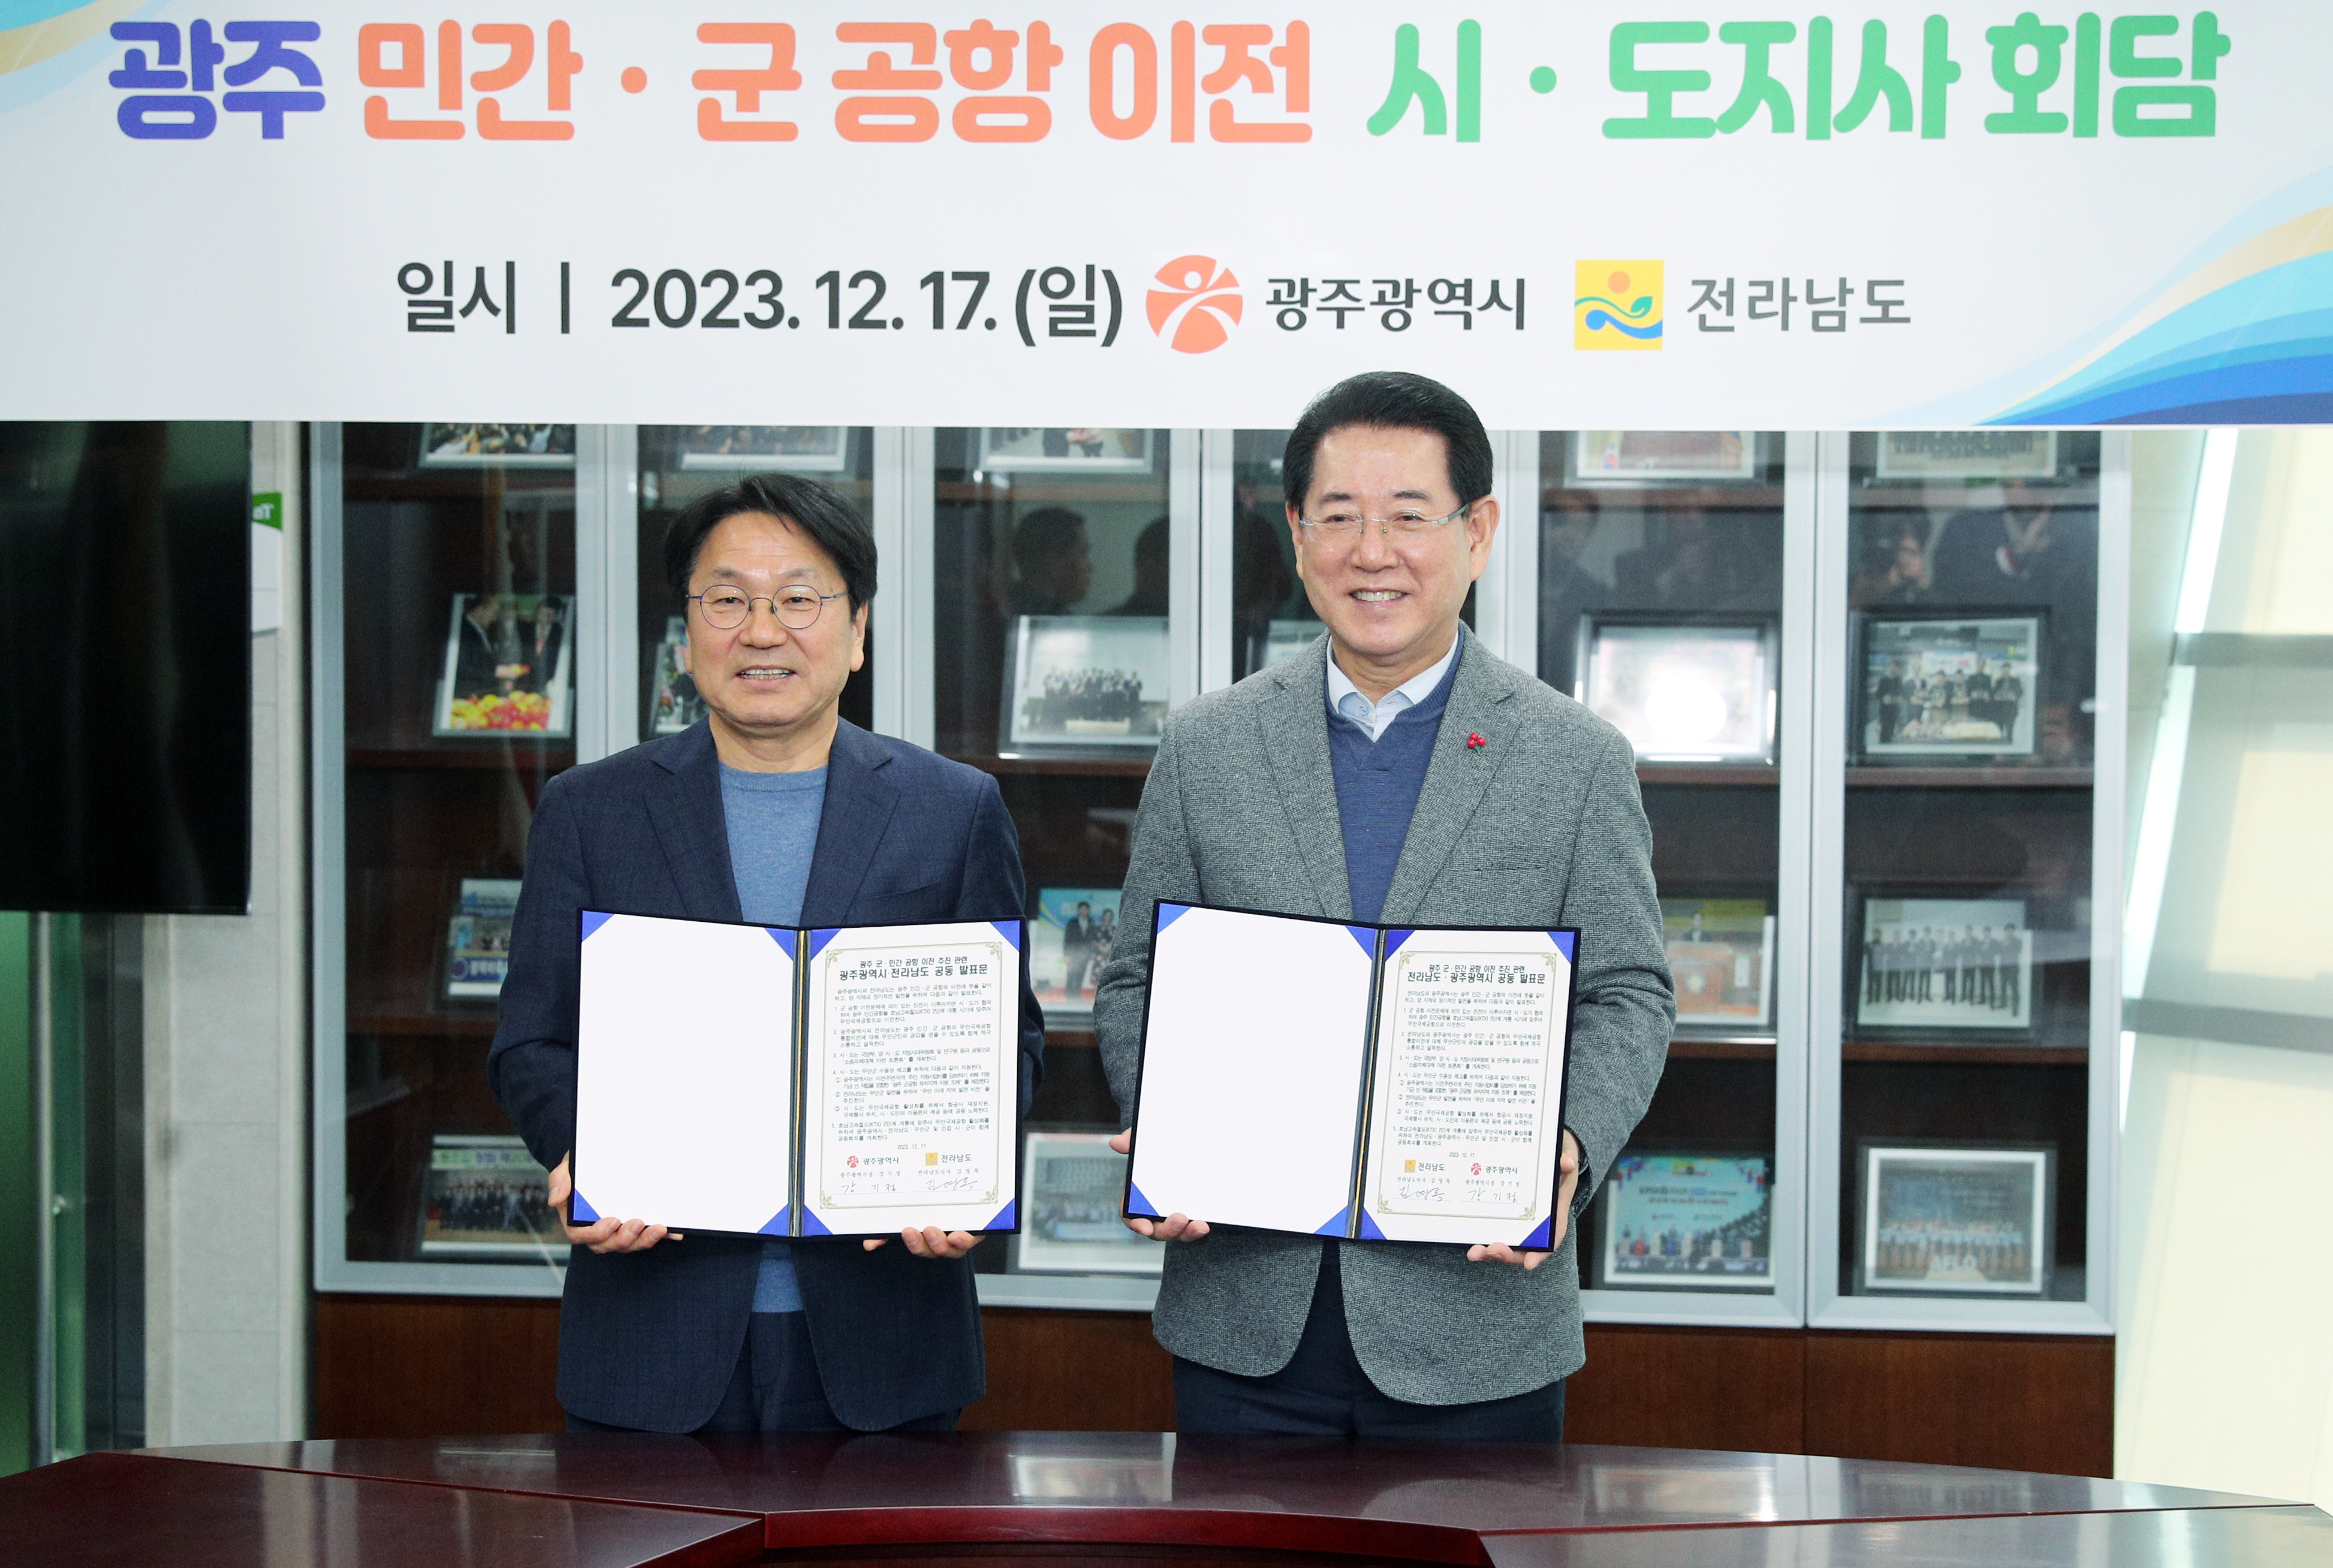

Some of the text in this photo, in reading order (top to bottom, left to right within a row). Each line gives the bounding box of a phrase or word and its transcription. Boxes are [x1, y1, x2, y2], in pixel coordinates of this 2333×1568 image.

[108, 19, 325, 140] 광주
[358, 19, 583, 141] 민간
[692, 22, 802, 141] 군
[832, 19, 1063, 143] 공항
[1089, 20, 1312, 143] 이전
[1367, 19, 1481, 142] 시
[1602, 14, 1961, 140] 도지사
[1984, 11, 2231, 138] 회담
[397, 260, 516, 334] 일시
[611, 269, 800, 329] 2023.
[816, 270, 904, 330] 12.
[920, 271, 996, 330] 17.
[1015, 264, 1122, 347] (일)
[1266, 278, 1525, 332] 광주광역시
[1688, 278, 1910, 331] 전라남도
[860, 960, 873, 969] 광주
[888, 958, 902, 967] 민간
[905, 958, 918, 966] 공항
[921, 957, 935, 966] 이전
[954, 955, 967, 964] 관련
[934, 965, 953, 976] 공동
[959, 964, 988, 975] 발표문
[1483, 964, 1496, 973] 이전
[1407, 971, 1545, 984] 전라남도 광주광역시 공동 발표문
[863, 1156, 899, 1165] 광주광역시
[941, 1153, 972, 1163] 전라남도
[1417, 1162, 1445, 1172] 전라남도
[1484, 1165, 1518, 1175] 광주광역시
